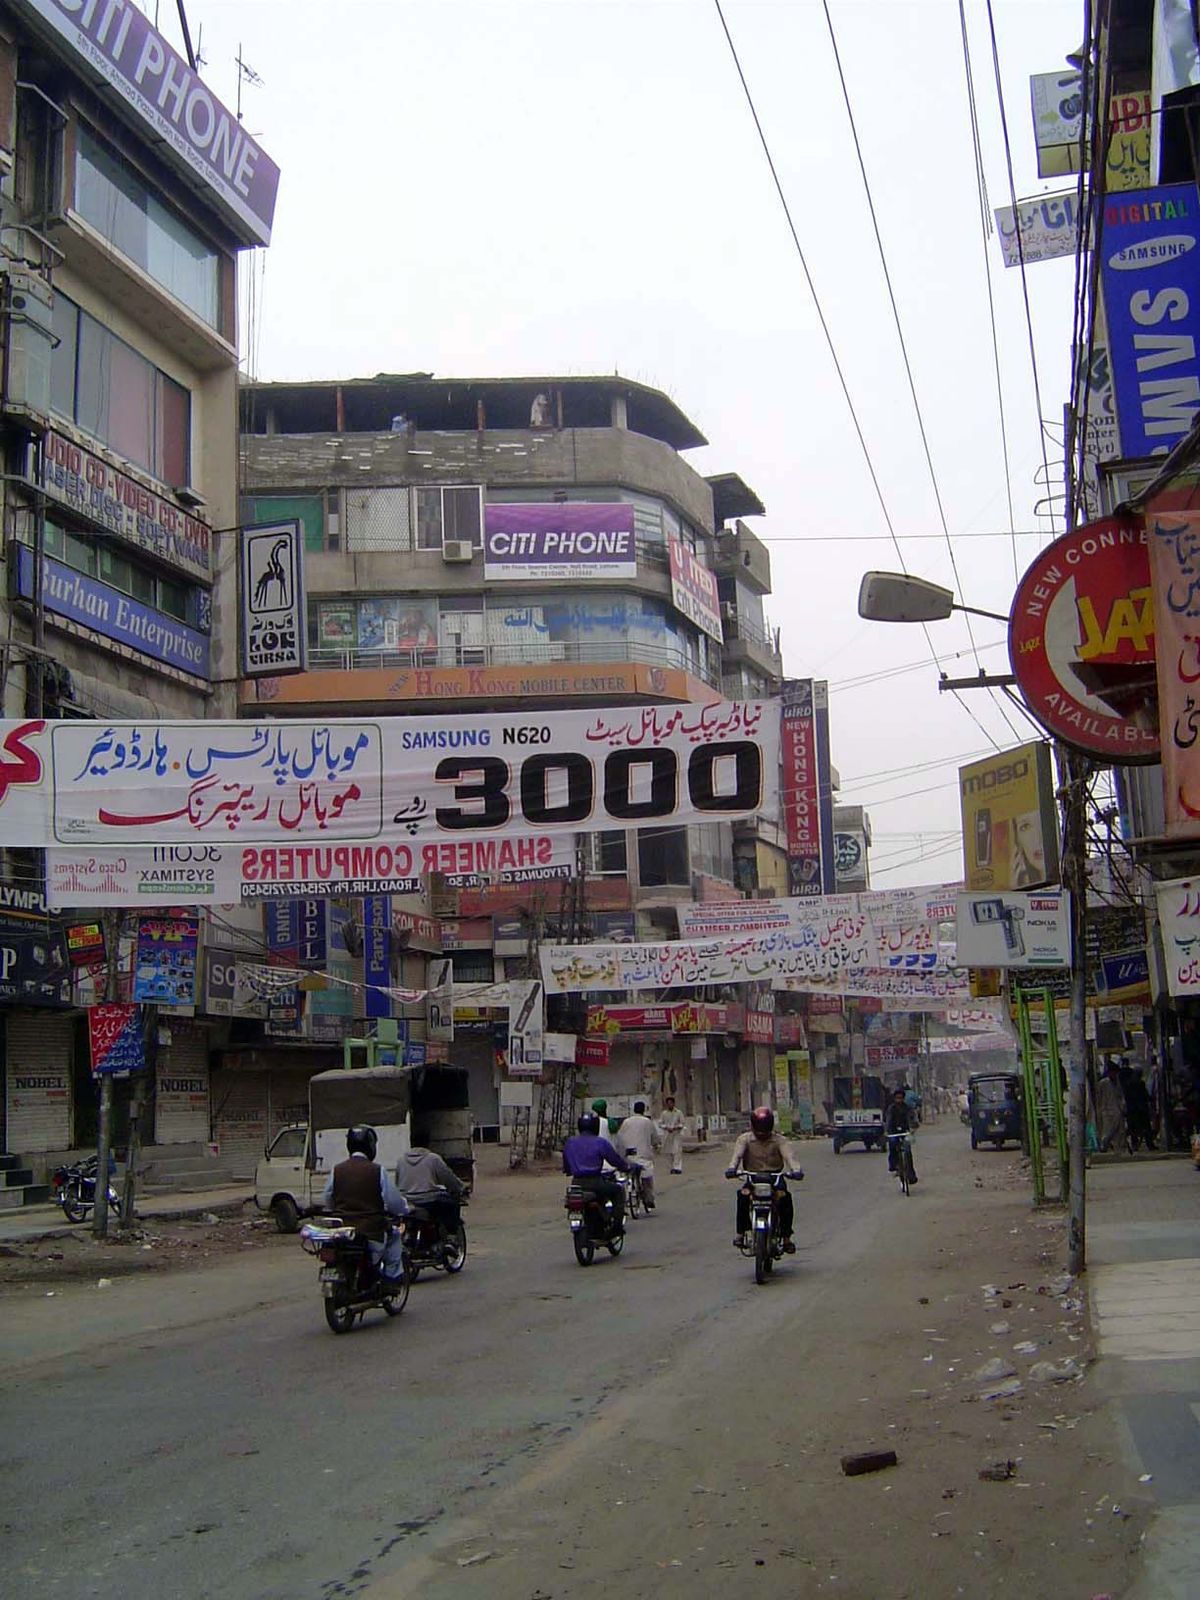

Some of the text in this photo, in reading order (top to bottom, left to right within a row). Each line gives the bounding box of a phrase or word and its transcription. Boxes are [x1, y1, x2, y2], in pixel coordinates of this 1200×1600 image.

[54, 0, 259, 196] ITI PHONE
[1104, 201, 1189, 226] DIGITAL
[1118, 244, 1187, 262] SAMSUNG
[1129, 287, 1200, 455] SAM
[44, 430, 81, 475] UDIO
[86, 456, 106, 490] CD
[115, 473, 156, 521] VIDEO
[159, 501, 177, 536] CD
[184, 514, 210, 552] DVD
[44, 460, 87, 502] ASER
[90, 486, 123, 522] DISC
[489, 531, 630, 555] CITI PHONE
[673, 541, 714, 597] UITED
[1027, 566, 1062, 617] NEW
[116, 597, 203, 666] Enterprise
[249, 630, 295, 653] LOK
[249, 650, 297, 666] VIRSA
[519, 678, 569, 695] MOBILE
[573, 677, 626, 692] CENTER
[586, 700, 763, 746] نیا ڈبہ پیک موبائل سیٹ
[786, 721, 811, 730] NEW
[402, 726, 551, 750] SAMSUNG N620
[186, 727, 291, 785] پارٹس
[292, 727, 370, 781] موبائل
[792, 731, 808, 783] HONG
[434, 740, 764, 832] 3000
[278, 782, 362, 831] موبائل
[393, 796, 429, 836] روپے
[795, 789, 811, 841] KONG
[790, 842, 817, 850] MOBILE
[790, 849, 818, 857] CENTER
[765, 932, 792, 952] بازی
[659, 945, 699, 966] پابندی
[829, 943, 851, 969] شوق
[661, 962, 685, 985] امن
[686, 964, 708, 982] میں
[160, 1078, 208, 1093] NOBEL
